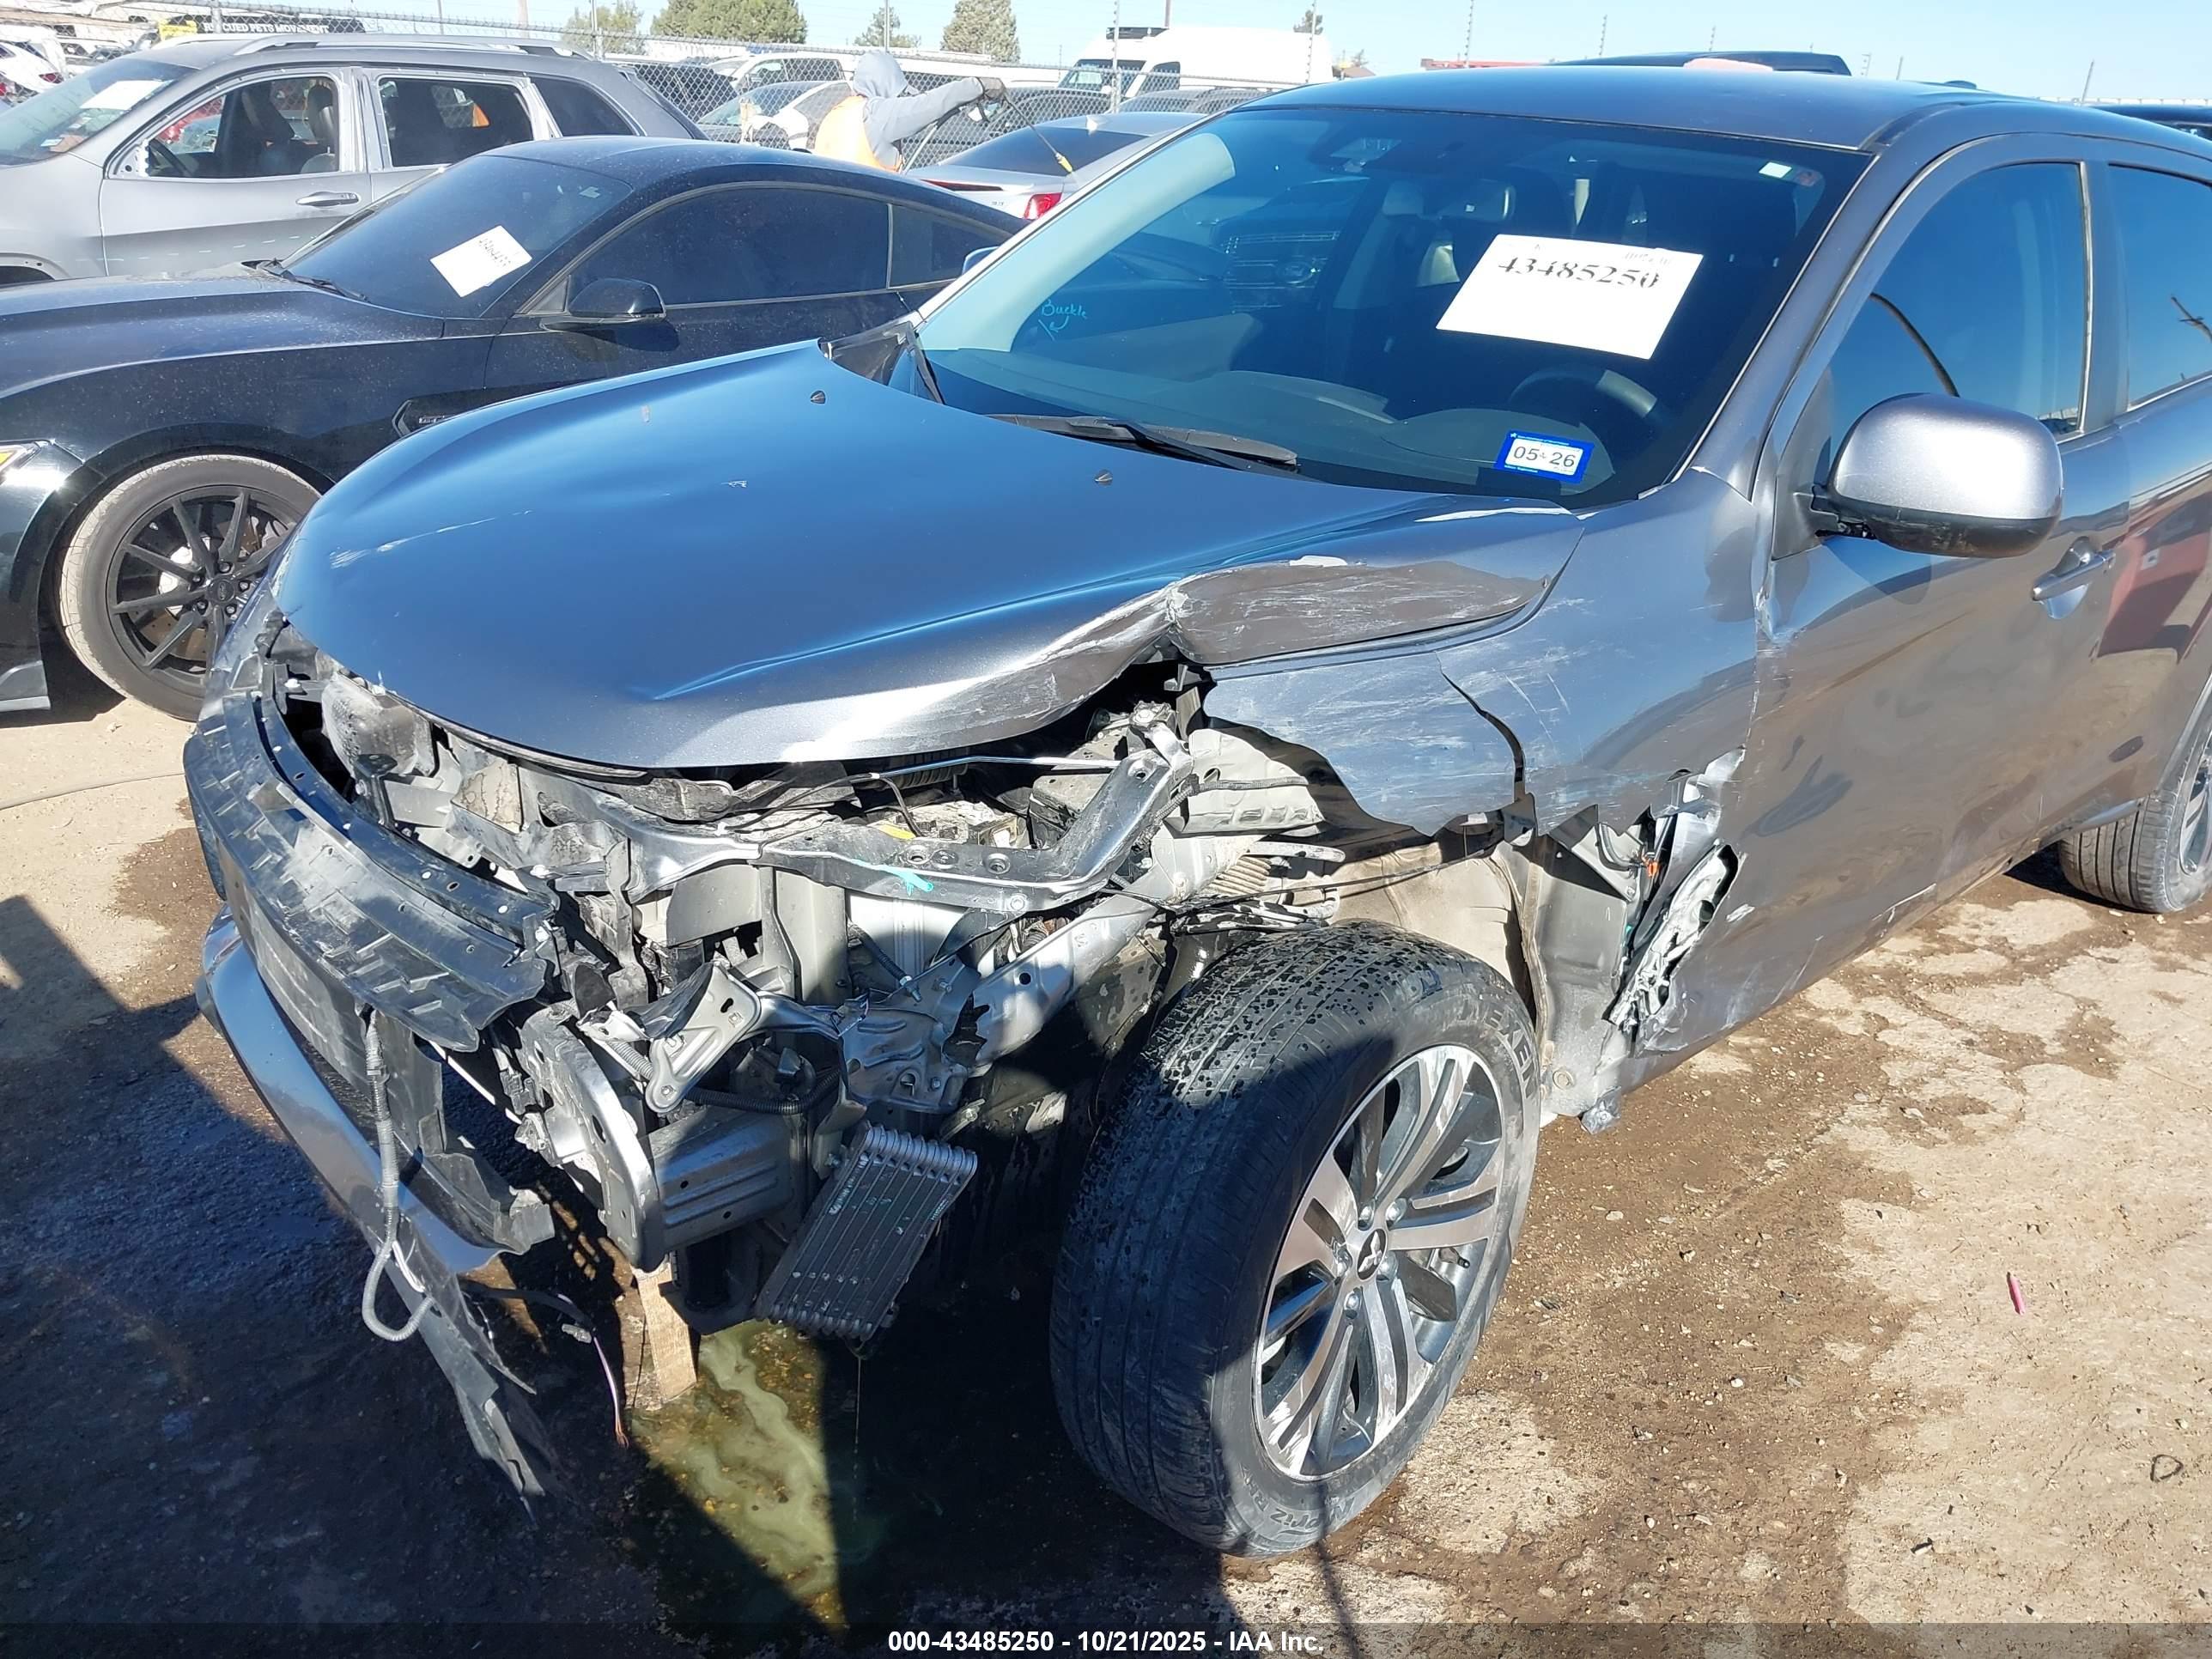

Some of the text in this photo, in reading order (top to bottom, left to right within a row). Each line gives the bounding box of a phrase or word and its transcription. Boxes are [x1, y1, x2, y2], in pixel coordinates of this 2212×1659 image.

[204, 21, 249, 33] RCUED
[249, 23, 275, 33] PETS
[1498, 257, 1660, 289] 43485250
[1514, 446, 1577, 467] 05 26
